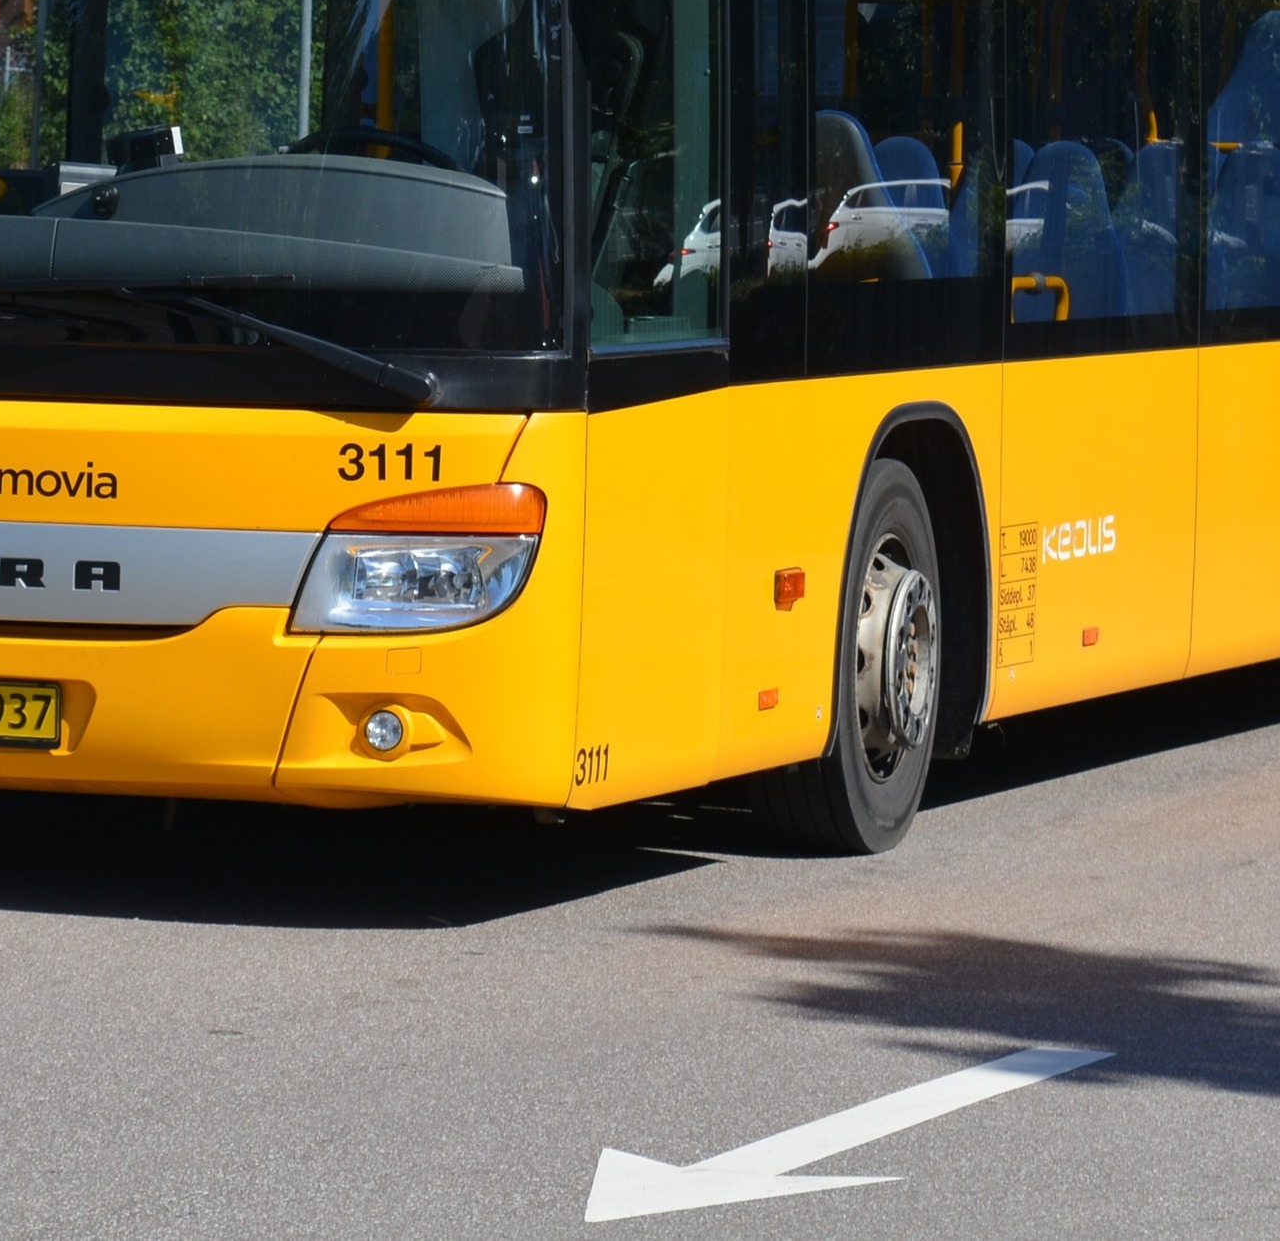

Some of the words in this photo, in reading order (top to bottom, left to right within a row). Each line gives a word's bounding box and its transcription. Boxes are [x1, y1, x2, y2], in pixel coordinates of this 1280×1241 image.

[337, 442, 444, 482] 3111
[1019, 529, 1037, 547] 19000
[1021, 557, 1036, 574] 7438
[1027, 584, 1036, 602] 37
[1026, 612, 1035, 630] 48
[575, 744, 610, 787] 3111
